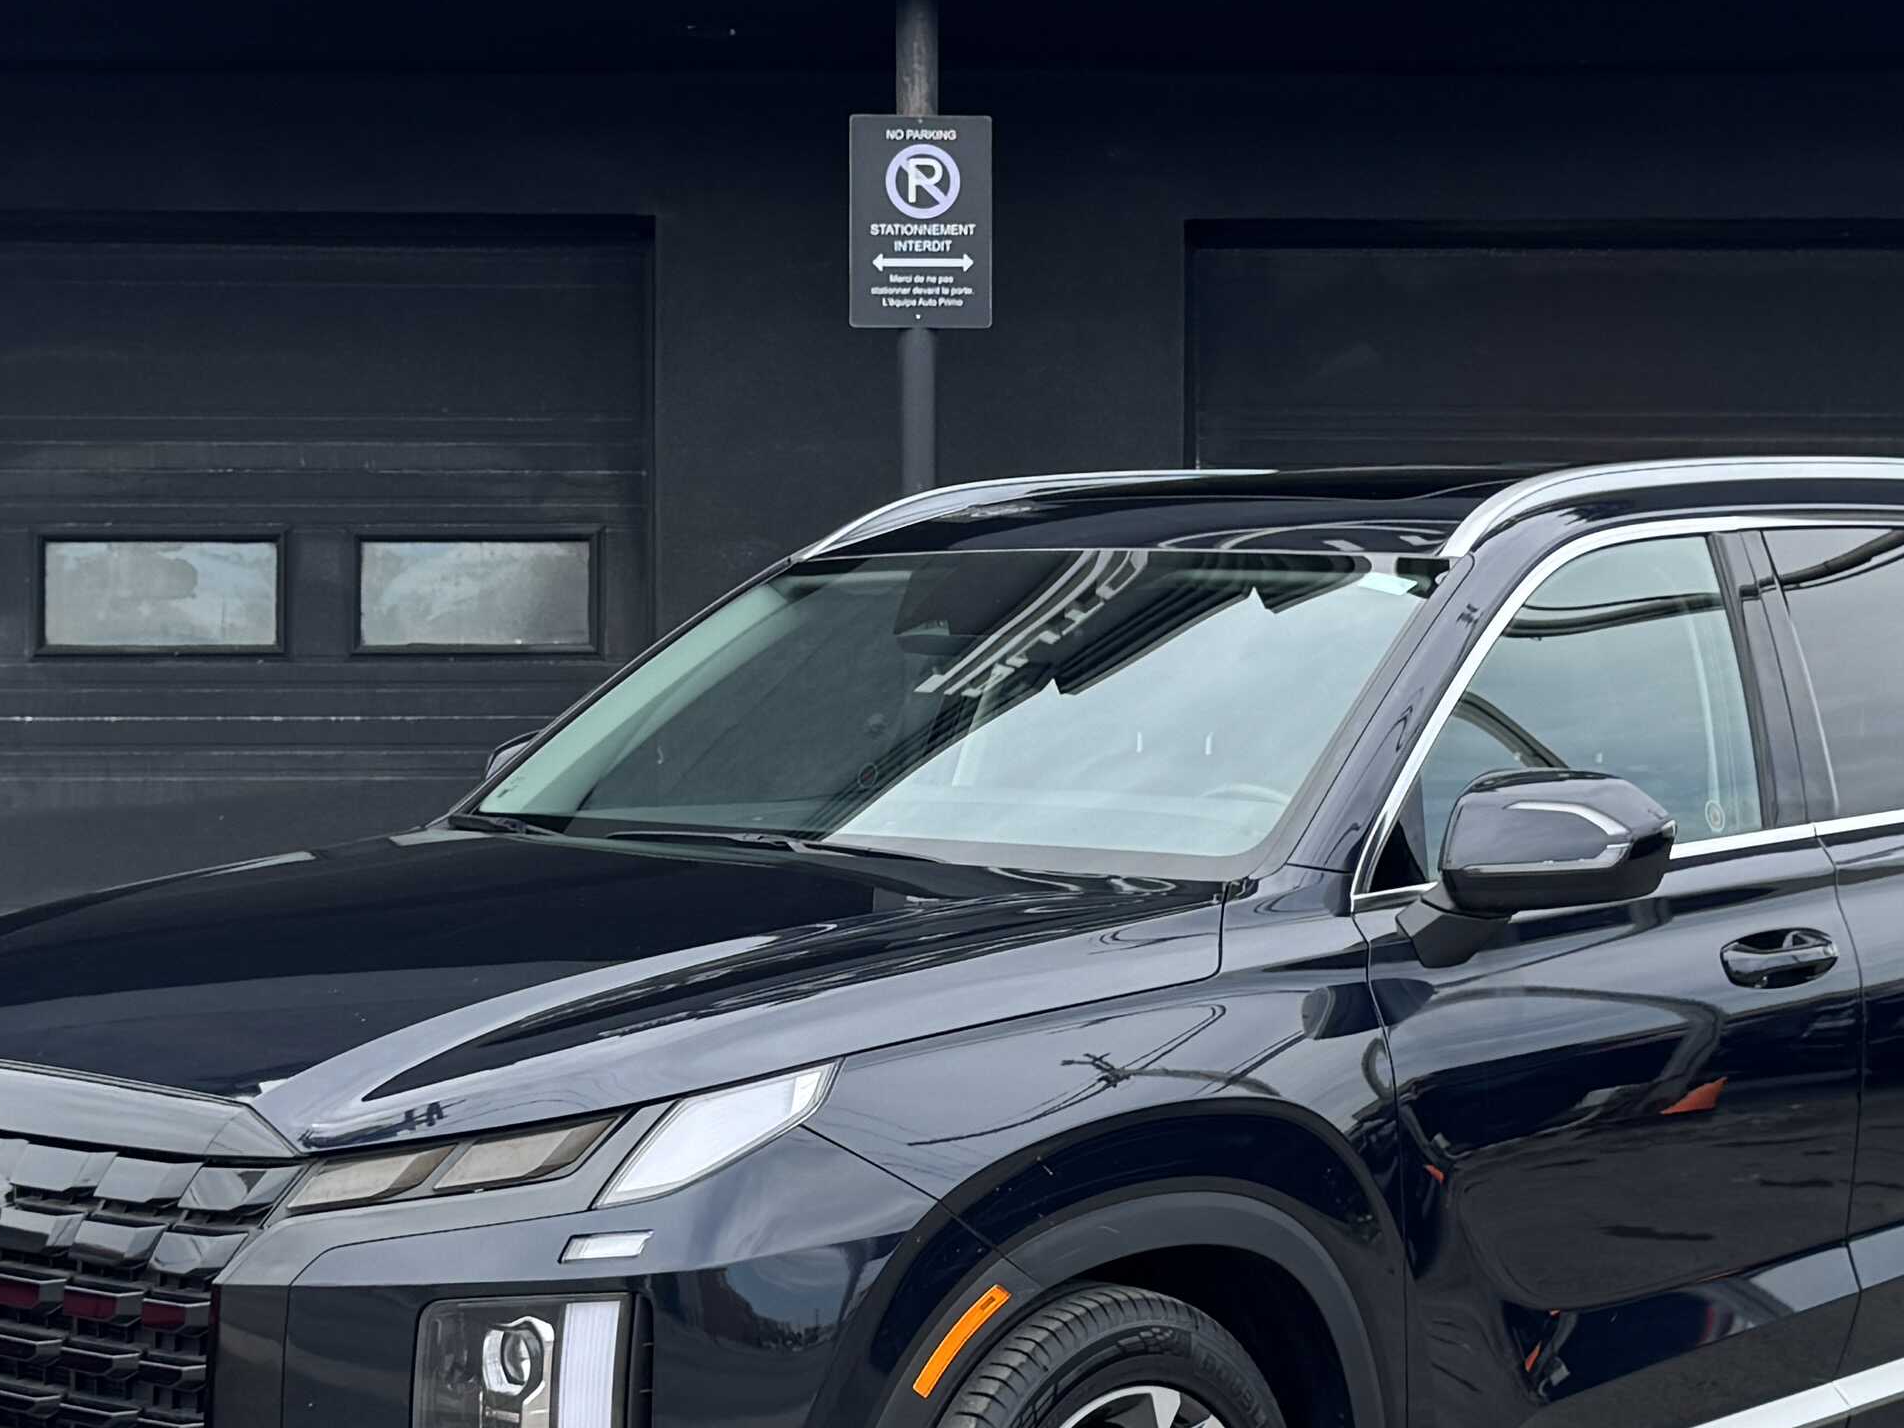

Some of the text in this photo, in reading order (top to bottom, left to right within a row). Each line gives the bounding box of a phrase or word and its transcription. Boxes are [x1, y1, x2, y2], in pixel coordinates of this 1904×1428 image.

[885, 129, 957, 141] NO PARKING
[870, 223, 976, 236] STATIONNEMENT
[894, 240, 953, 252] INTERDIT
